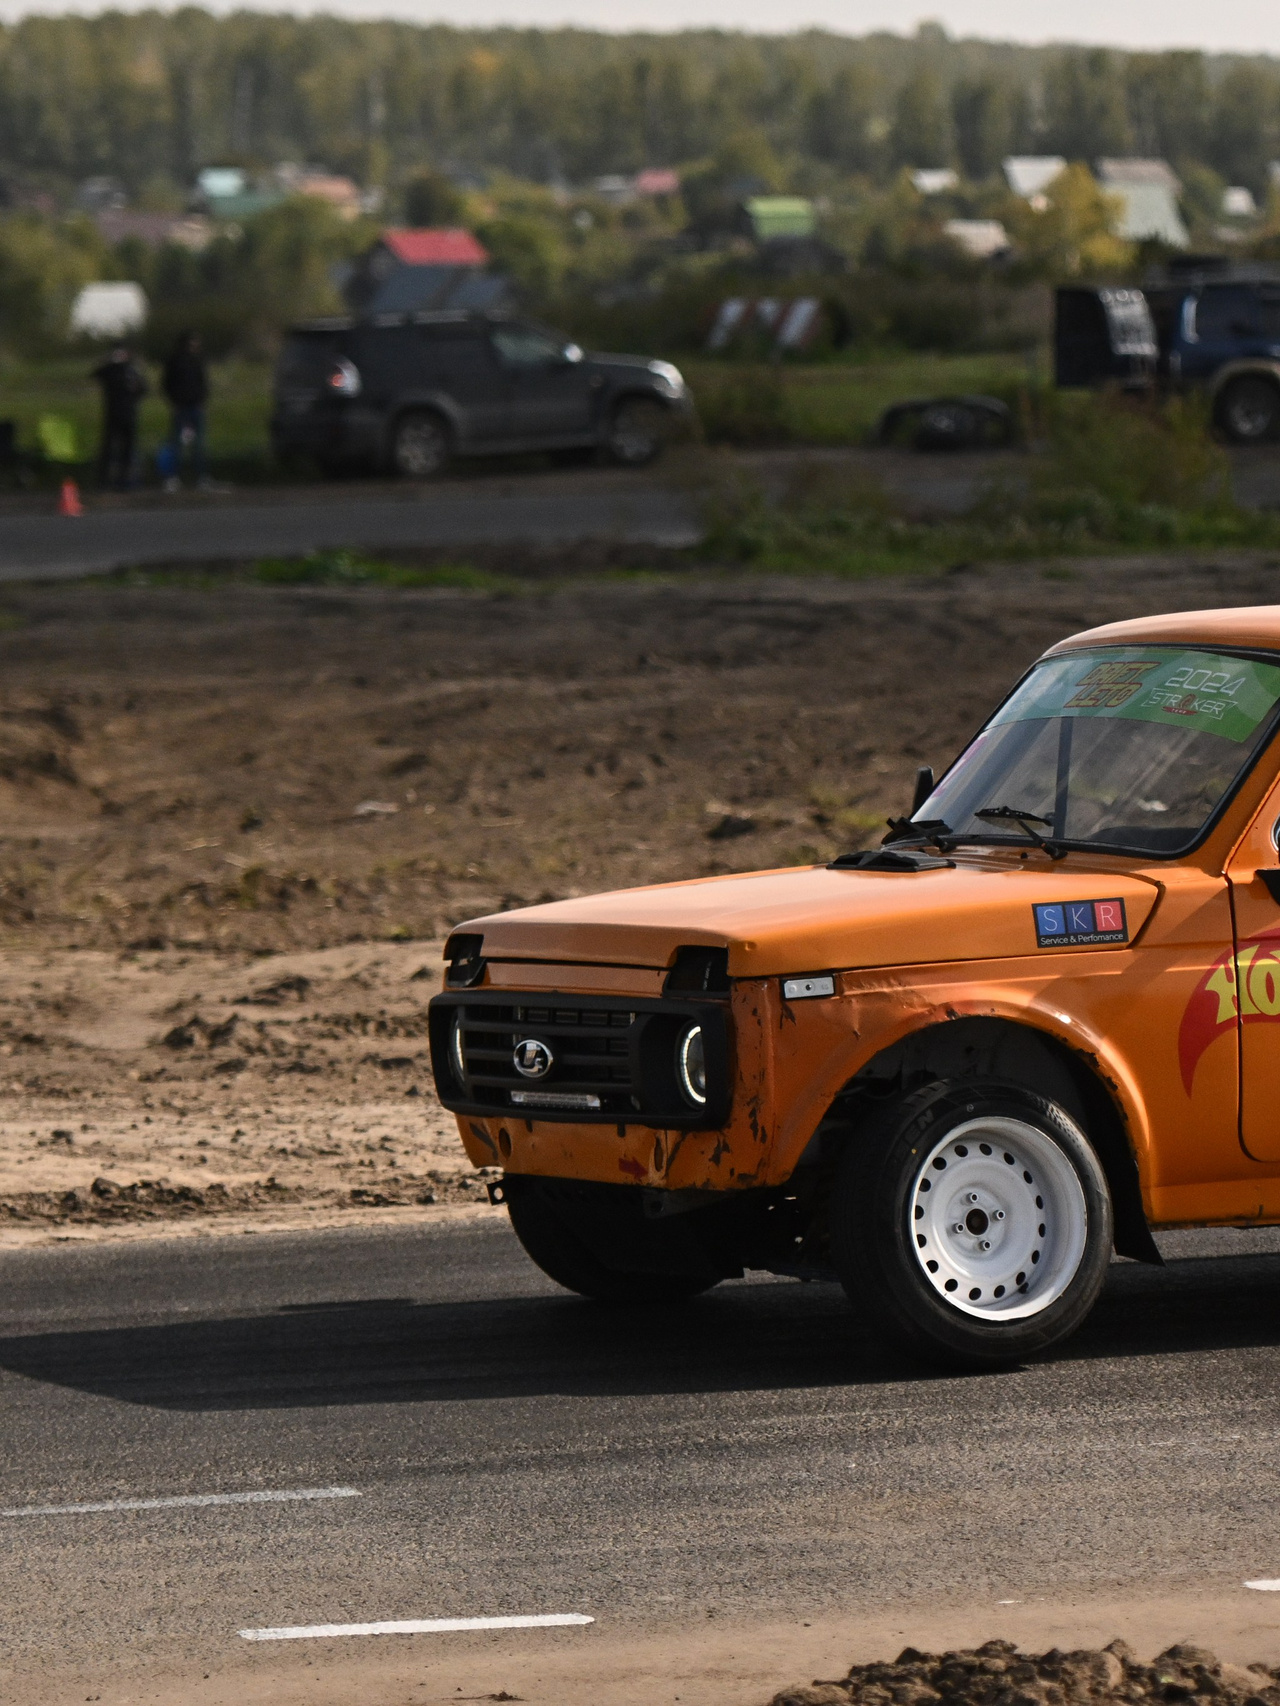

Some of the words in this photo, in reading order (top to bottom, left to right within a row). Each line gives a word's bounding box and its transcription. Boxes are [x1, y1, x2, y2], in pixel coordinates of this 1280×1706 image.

[1164, 667, 1246, 697] 2024
[1040, 936, 1068, 945] Service
[1070, 935, 1077, 943] &
